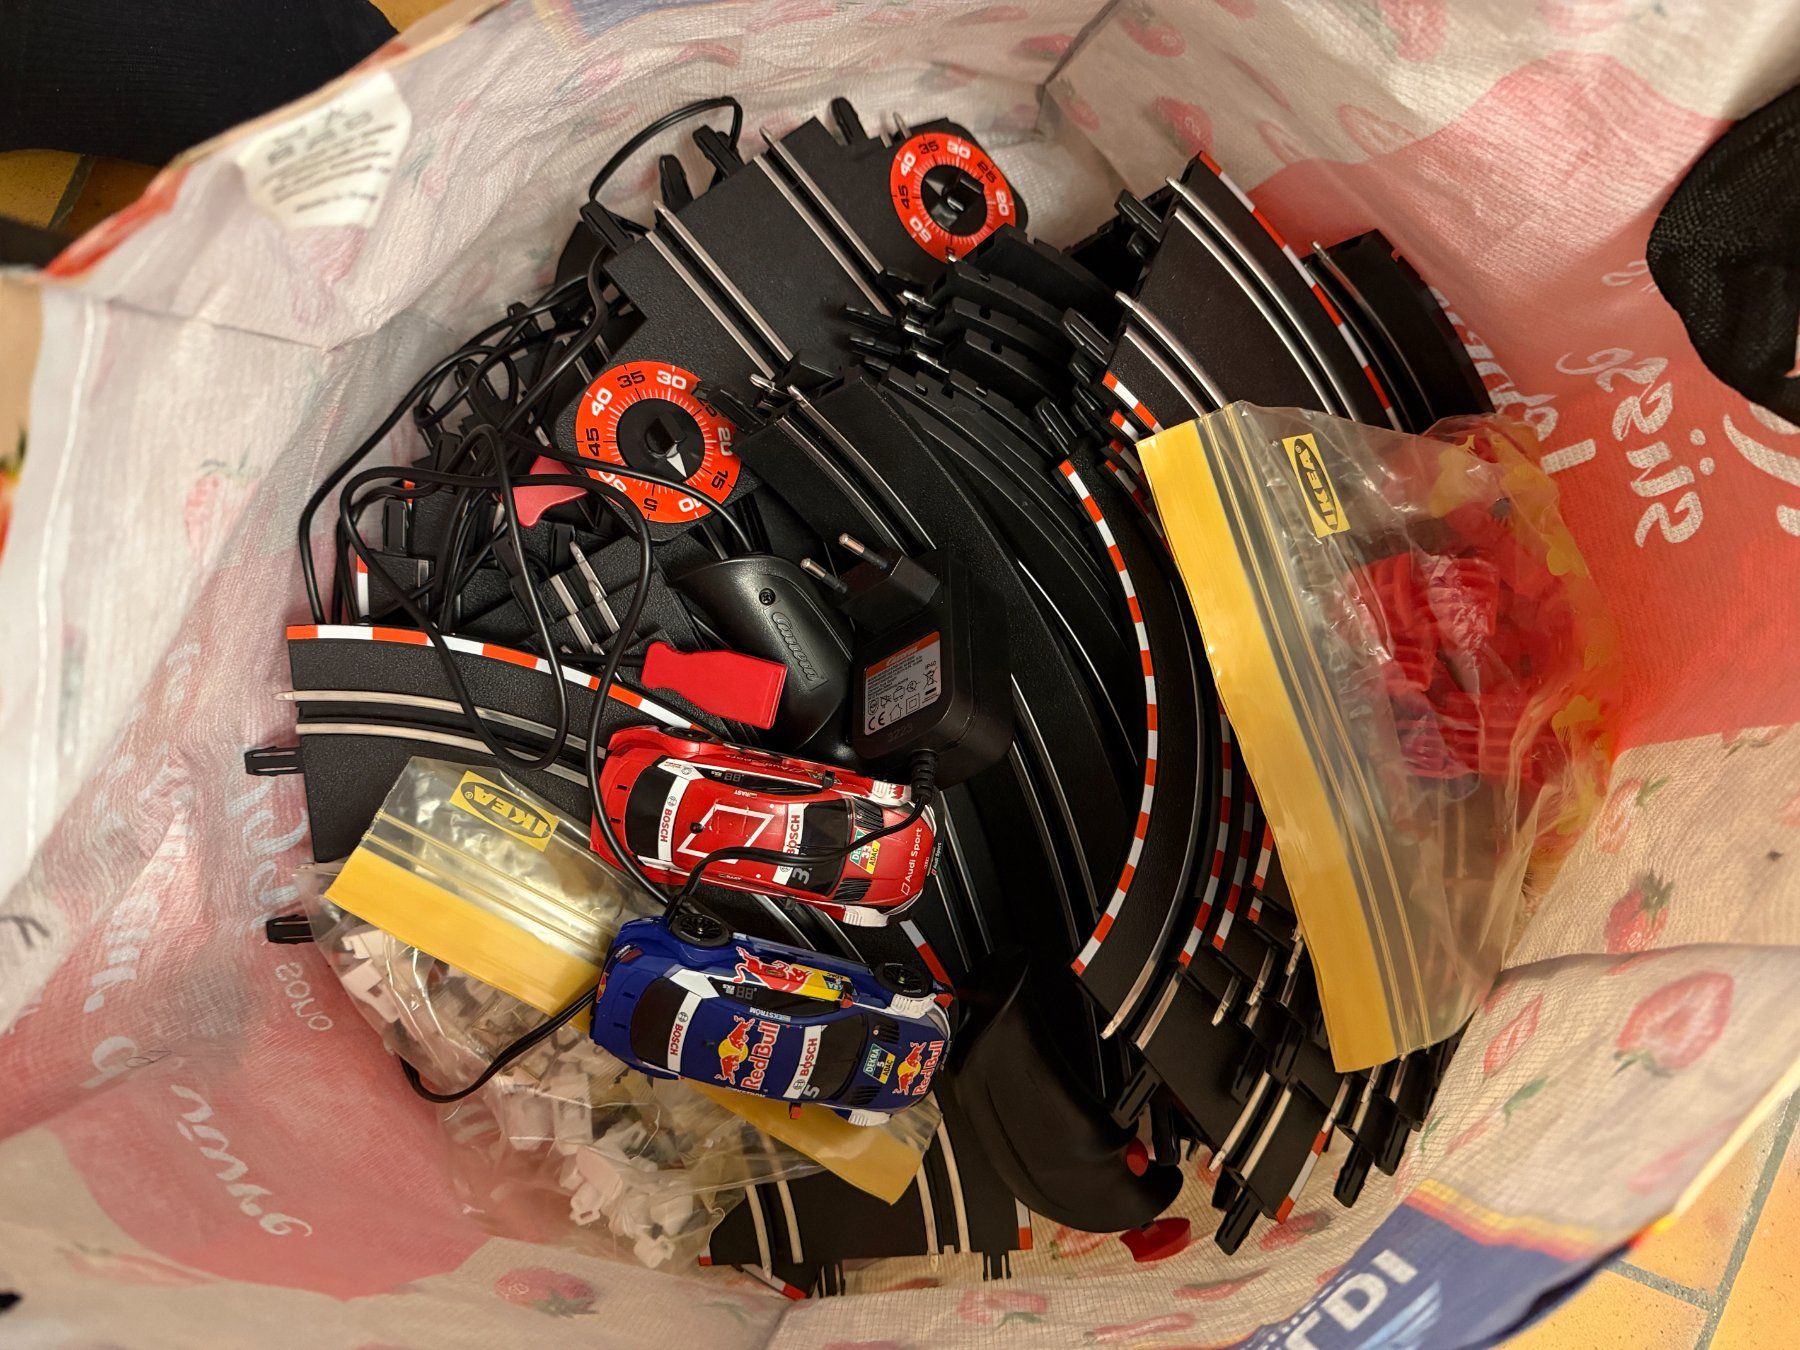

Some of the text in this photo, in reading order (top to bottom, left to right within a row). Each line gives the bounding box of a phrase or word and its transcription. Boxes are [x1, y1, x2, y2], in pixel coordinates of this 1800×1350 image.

[918, 140, 940, 155] 35
[947, 139, 971, 160] 30
[900, 151, 916, 177] 40
[977, 160, 997, 184] 25
[898, 184, 910, 210] 45
[995, 189, 1010, 217] 20
[909, 215, 932, 243] 50
[617, 370, 646, 389] 35
[656, 369, 687, 391] 30
[591, 387, 613, 417] 40
[585, 426, 600, 457] 45
[711, 470, 729, 491] 15
[643, 497, 659, 512] 5
[772, 611, 820, 682] Carrera
[660, 808, 673, 843] BOSCH
[861, 845, 872, 859] 33
[868, 848, 879, 866] ADAC
[905, 827, 923, 883] Audi Sport
[670, 1023, 684, 1056] BOSCH
[800, 1037, 818, 1077] BOSCH
[866, 1048, 880, 1073] DEKRA
[882, 1059, 893, 1076] ADAC
[804, 1084, 820, 1098] 5
